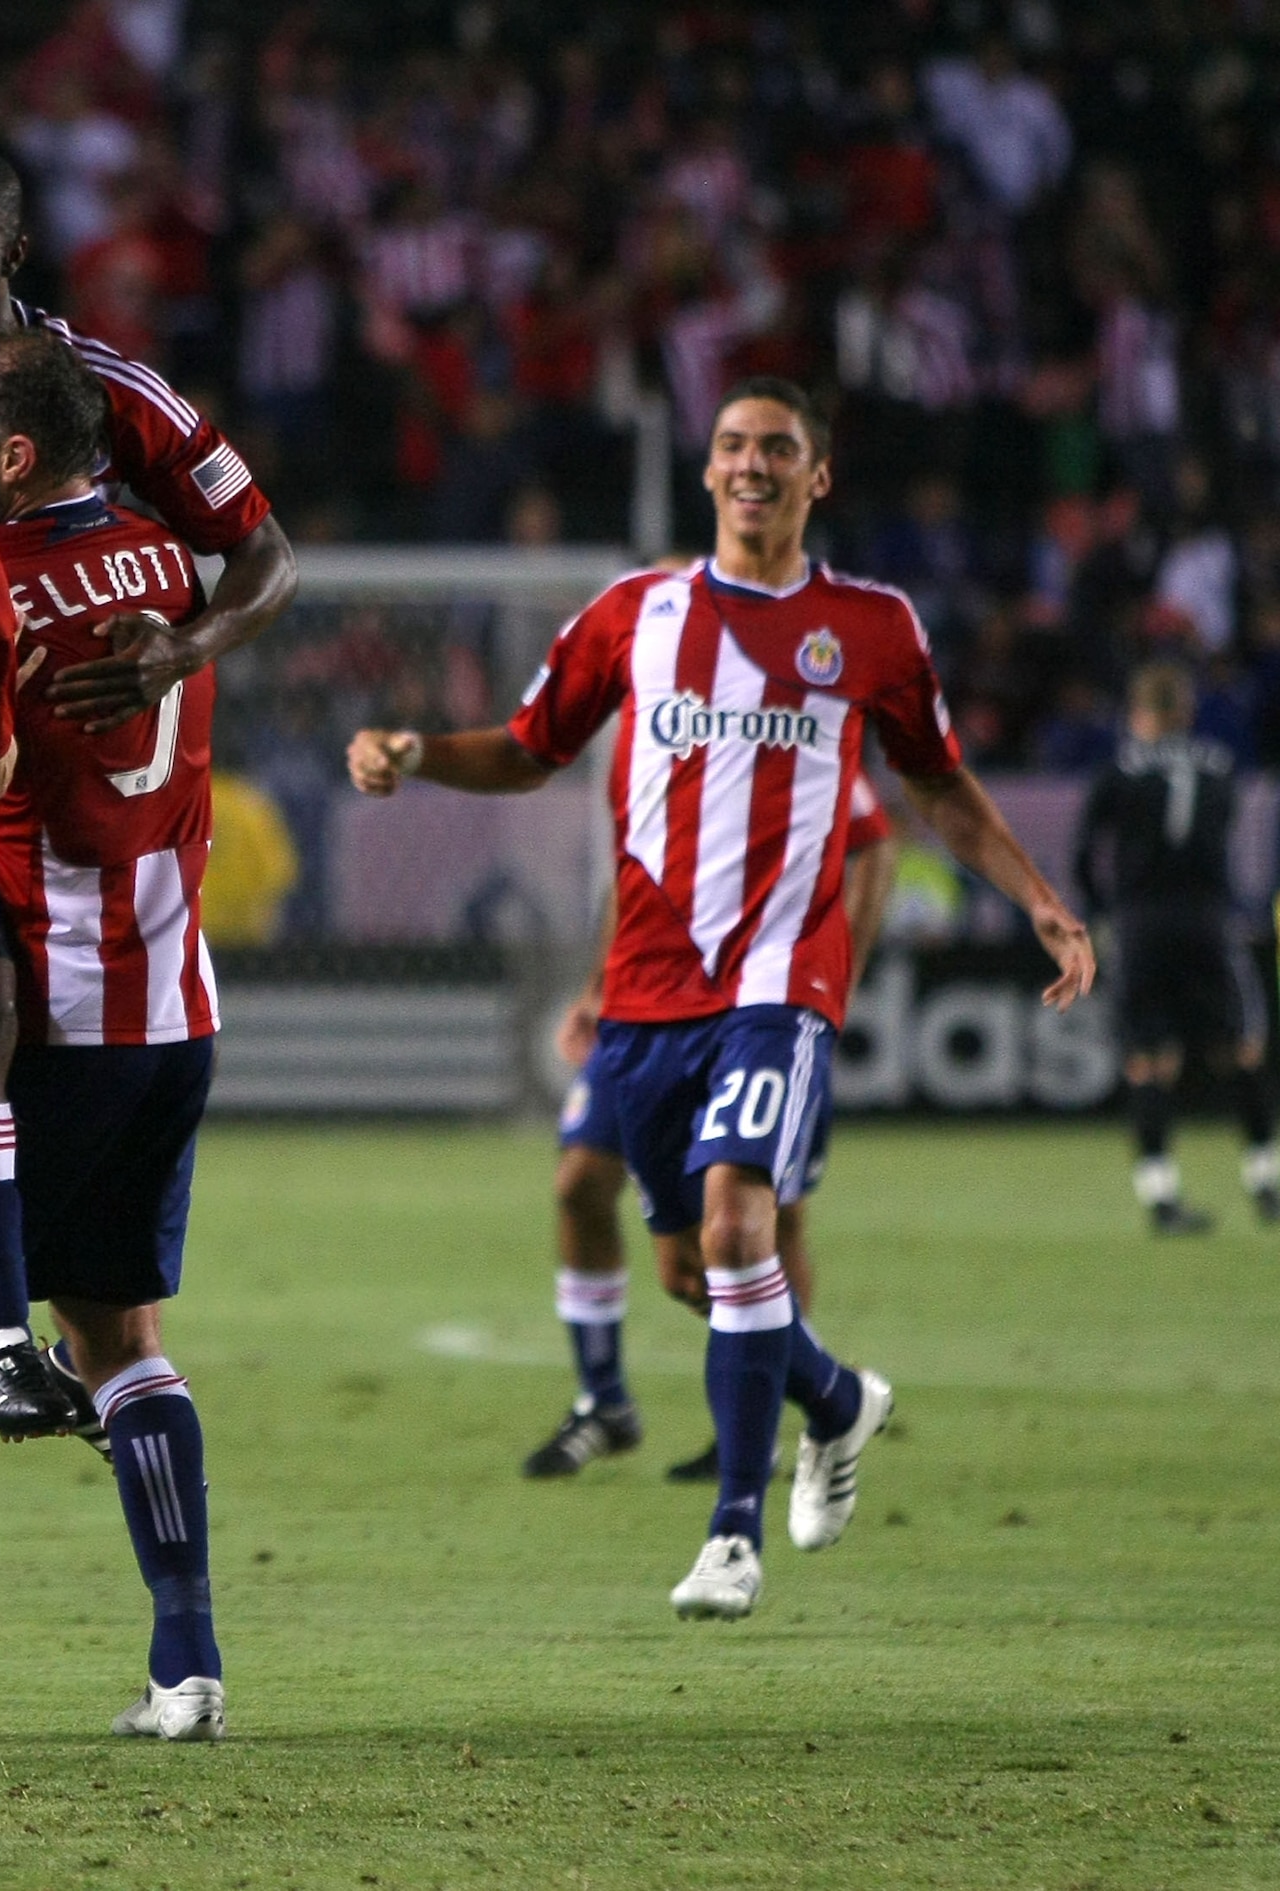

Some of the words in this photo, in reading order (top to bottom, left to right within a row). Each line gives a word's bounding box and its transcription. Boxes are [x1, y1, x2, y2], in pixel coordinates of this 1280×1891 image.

[9, 542, 189, 632] ELLIOTT
[650, 691, 819, 757] Corona
[700, 1067, 786, 1141] 20
